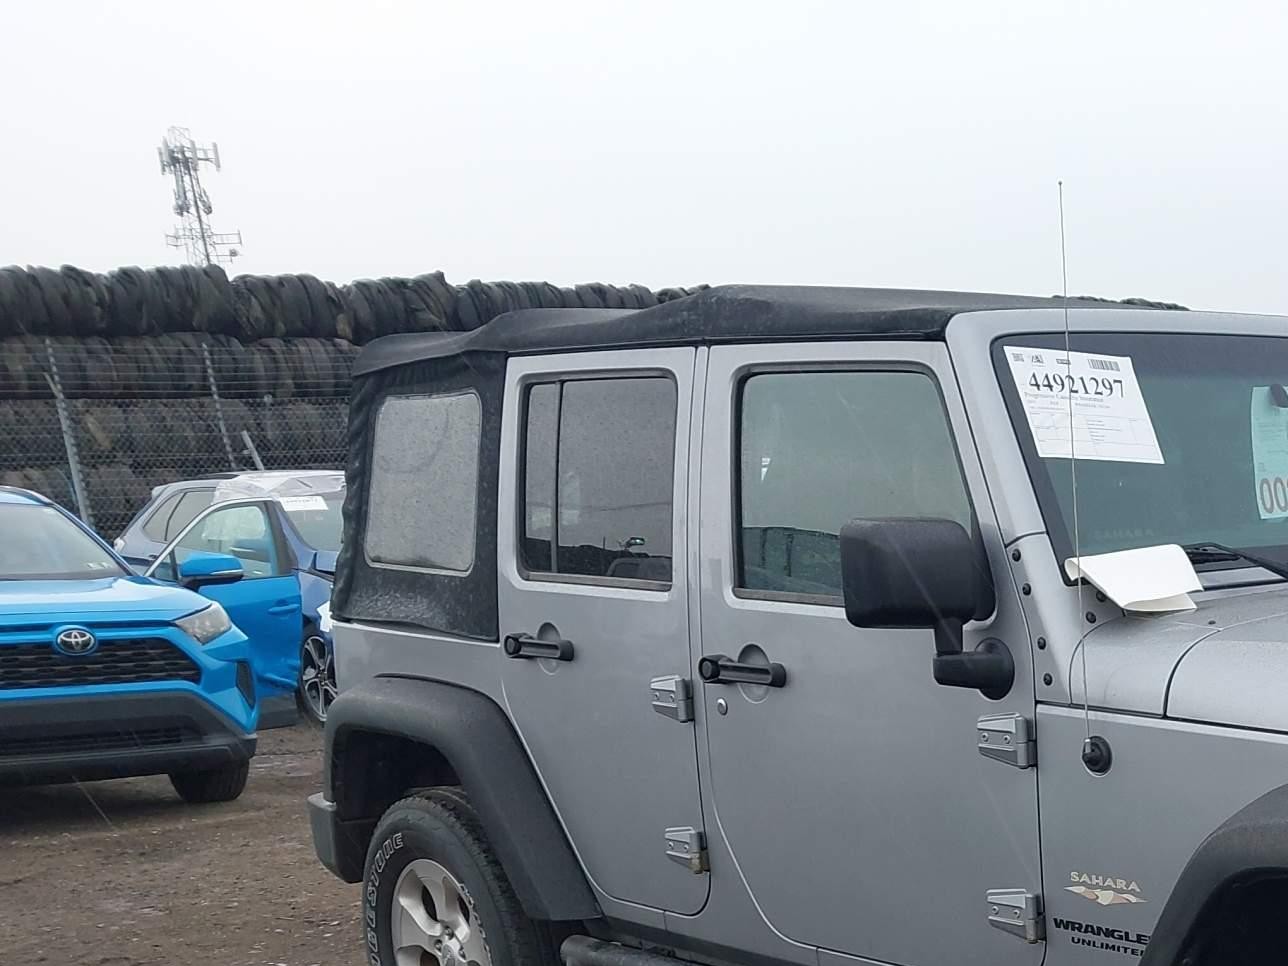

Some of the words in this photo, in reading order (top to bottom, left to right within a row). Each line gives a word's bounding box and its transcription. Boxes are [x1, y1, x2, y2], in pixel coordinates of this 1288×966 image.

[1029, 372, 1123, 398] 44921297
[1070, 871, 1140, 892] SAHARA
[1053, 918, 1151, 945] WRANGLE
[1071, 936, 1144, 957] UNLIMITE
